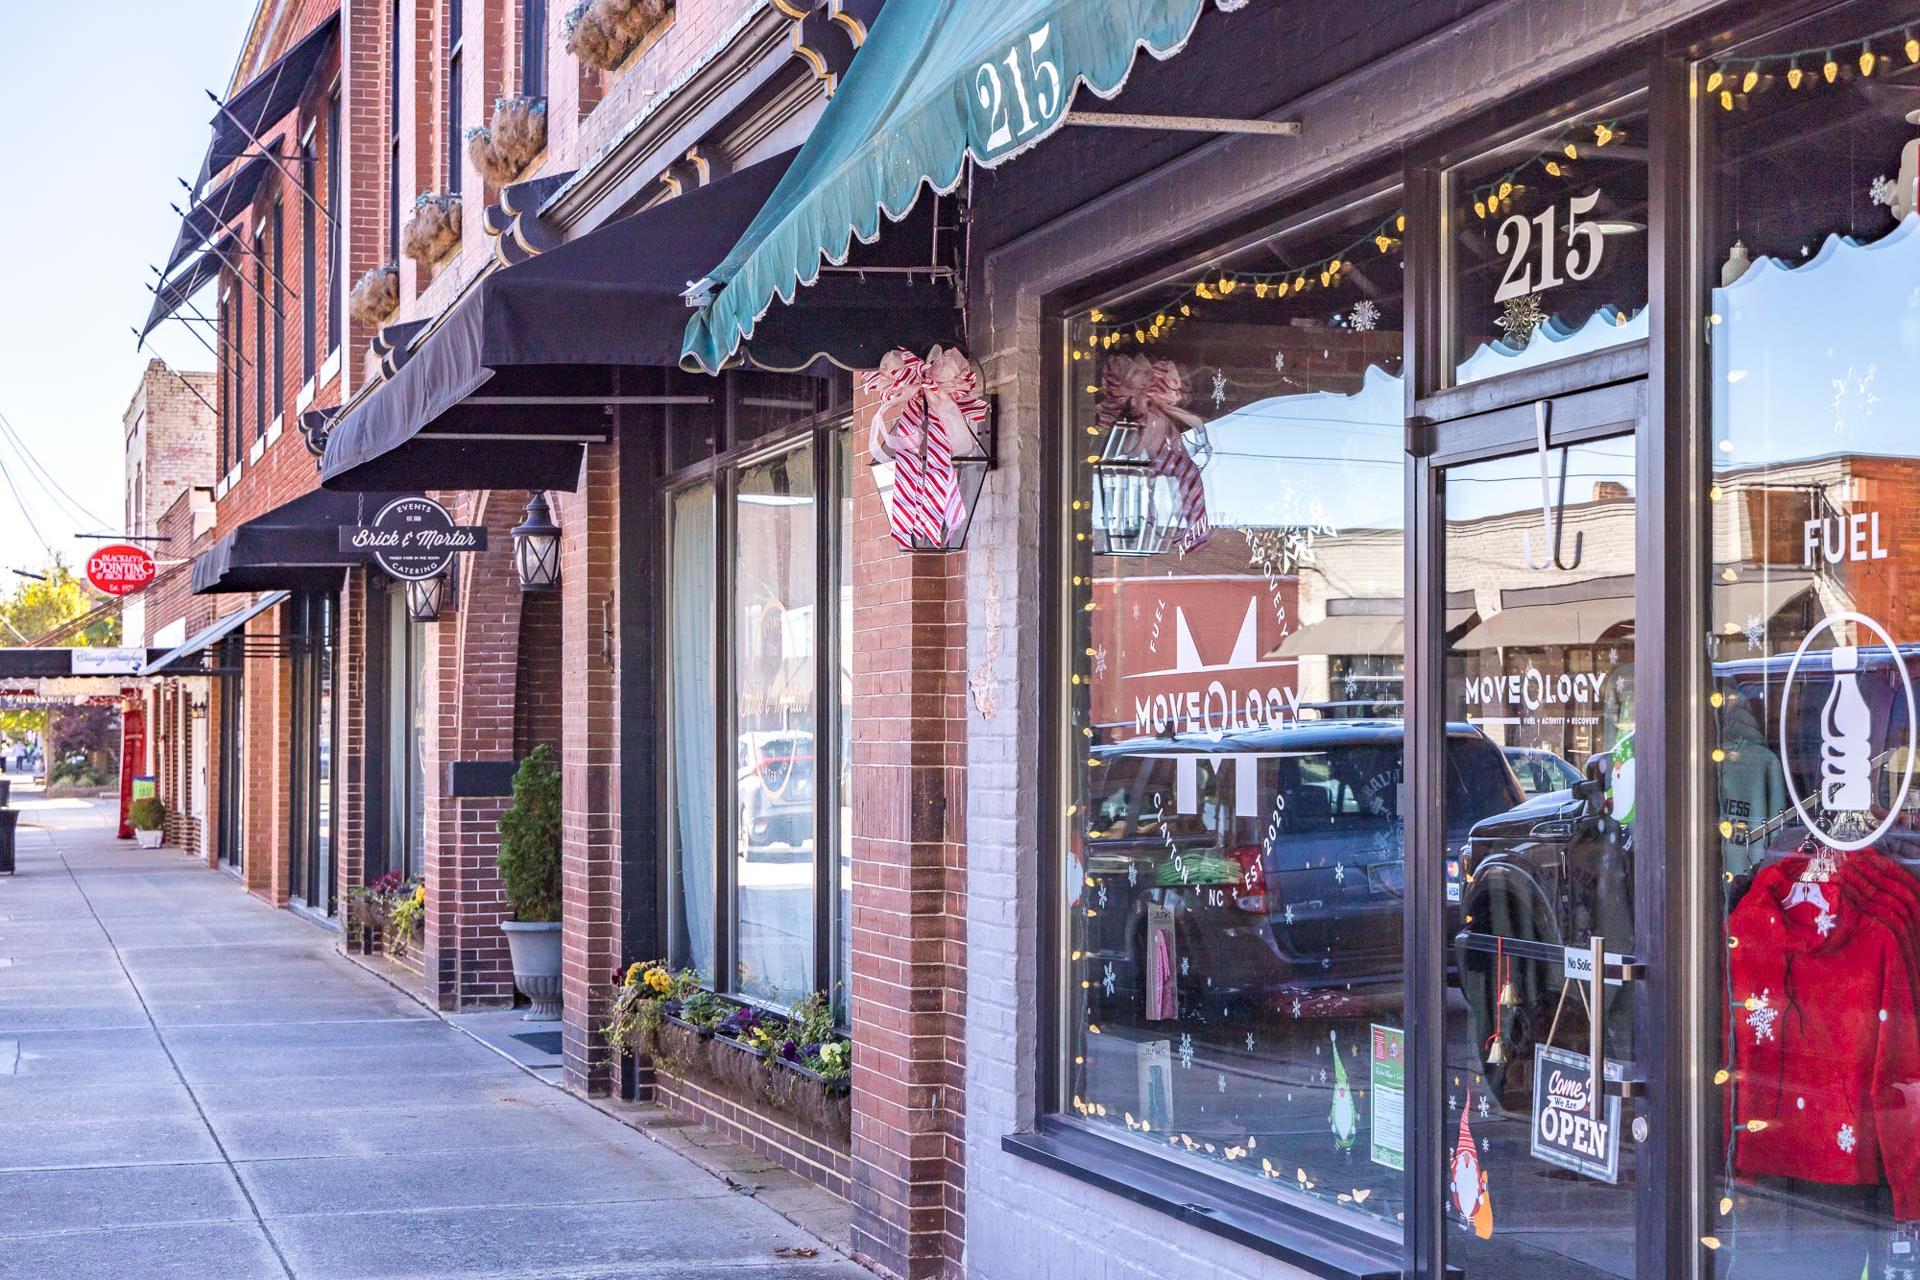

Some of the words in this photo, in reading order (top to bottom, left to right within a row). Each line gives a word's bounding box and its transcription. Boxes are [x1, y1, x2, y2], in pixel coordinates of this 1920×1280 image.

[975, 21, 1060, 152] 215
[1494, 188, 1604, 303] 215
[396, 503, 432, 513] EVENTS
[352, 529, 400, 547] Brick
[416, 529, 476, 550] Mortar
[1804, 511, 1888, 567] FUEL
[91, 558, 154, 575] PRINTING
[392, 562, 438, 574] CATERING
[1149, 599, 1167, 655] FUEL
[1245, 528, 1289, 637] RECOVERY
[1465, 668, 1607, 711] MOVEOLOGY
[1135, 680, 1307, 743] MOVEOLOGY
[1523, 717, 1536, 725] FUEL
[1541, 717, 1565, 725] ACTIVITY
[1571, 717, 1599, 725] RECOVERY
[1153, 792, 1189, 885] CLAYTON
[1208, 889, 1224, 907] NC
[1244, 854, 1263, 891] EST
[1263, 794, 1285, 856] 2020
[1567, 958, 1576, 970] No
[1576, 959, 1592, 972] Solic
[1548, 1070, 1585, 1099] Come
[1553, 1097, 1564, 1109] We
[1566, 1099, 1577, 1110] Are
[1540, 1106, 1608, 1159] OPEN
